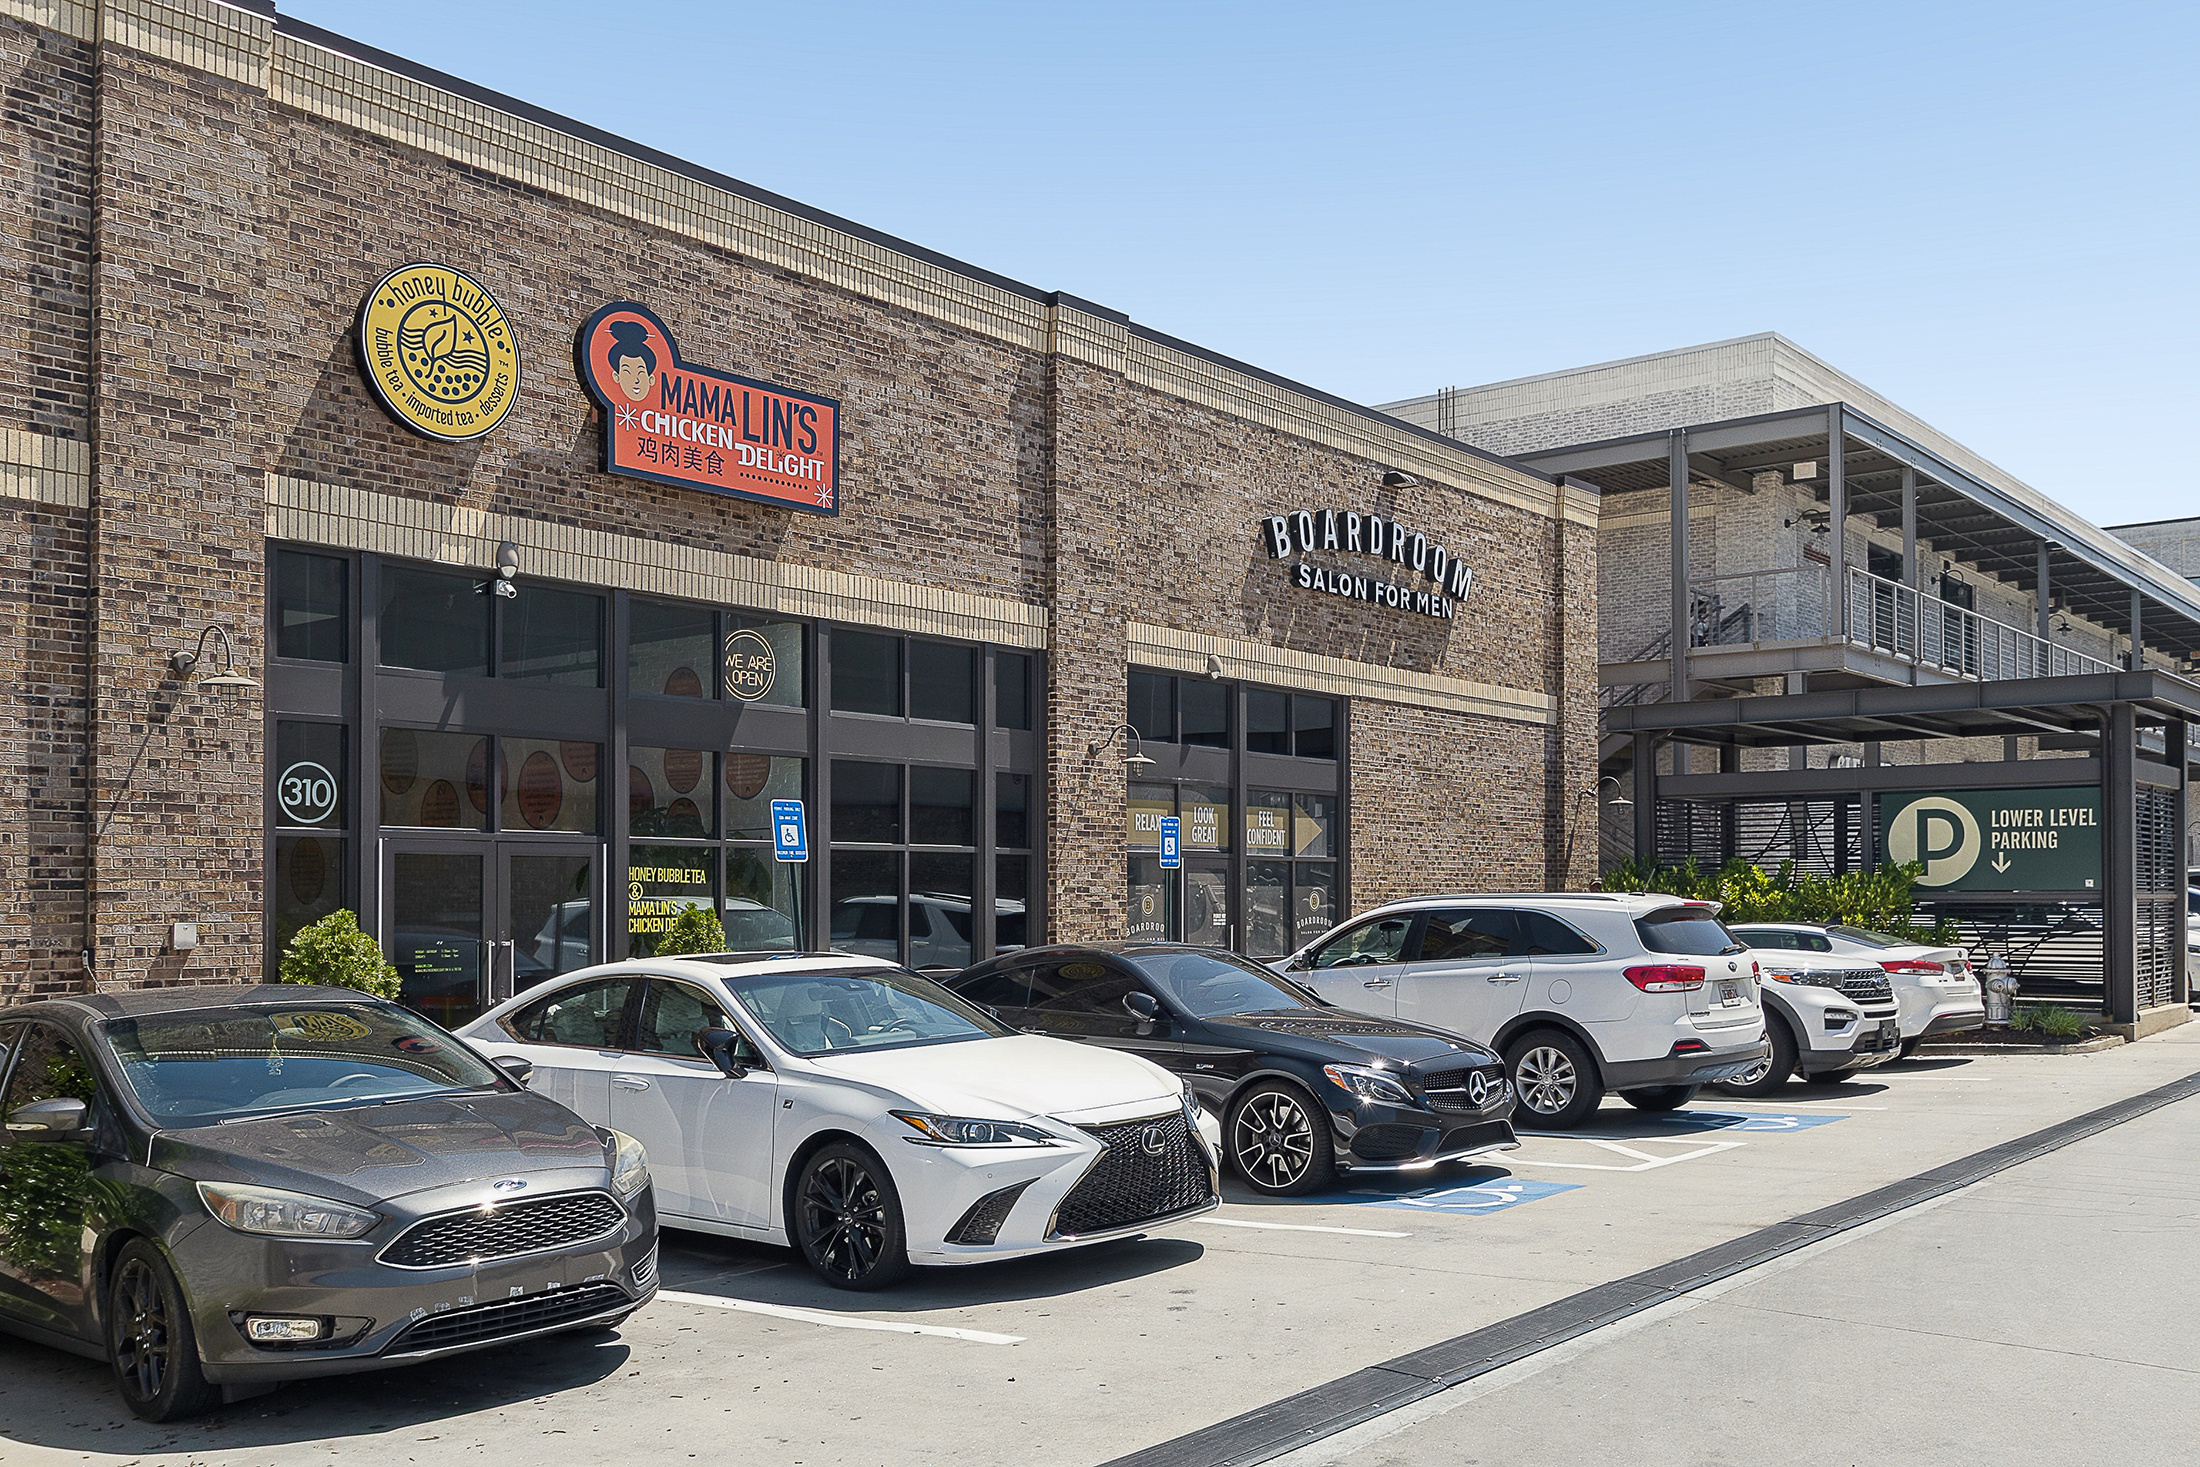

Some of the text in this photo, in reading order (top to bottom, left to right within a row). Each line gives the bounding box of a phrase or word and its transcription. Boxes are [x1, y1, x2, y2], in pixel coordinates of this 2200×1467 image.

[387, 275, 503, 339] honey bubble
[375, 327, 509, 426] bubble tea imported tea desserts
[661, 372, 817, 454] MAMA LIN'S
[640, 410, 733, 450] CHICKEN
[636, 436, 725, 477] 鸡肉美食
[1271, 509, 1473, 602] BOARDROOM
[1298, 563, 1453, 619] SALON FOR MEN
[725, 654, 772, 671] WE ARE
[732, 669, 763, 687] OPEN
[284, 777, 332, 808] 310
[1135, 813, 1160, 831] RELAX
[1193, 806, 1215, 824] LOOK
[1258, 811, 1274, 827] FEEL
[1991, 808, 2097, 828] LOWER LEVEL
[1191, 826, 1217, 843] GREAT
[1246, 828, 1286, 846] CONFIDENT
[1916, 808, 1965, 877] P
[1991, 831, 2058, 850] PARKING
[628, 866, 706, 884] HONEY BUBBLE TEA
[628, 901, 678, 916] MAMA LIN'S
[628, 918, 664, 933] CHICKEN
[1127, 921, 1165, 937] BOARDROO
